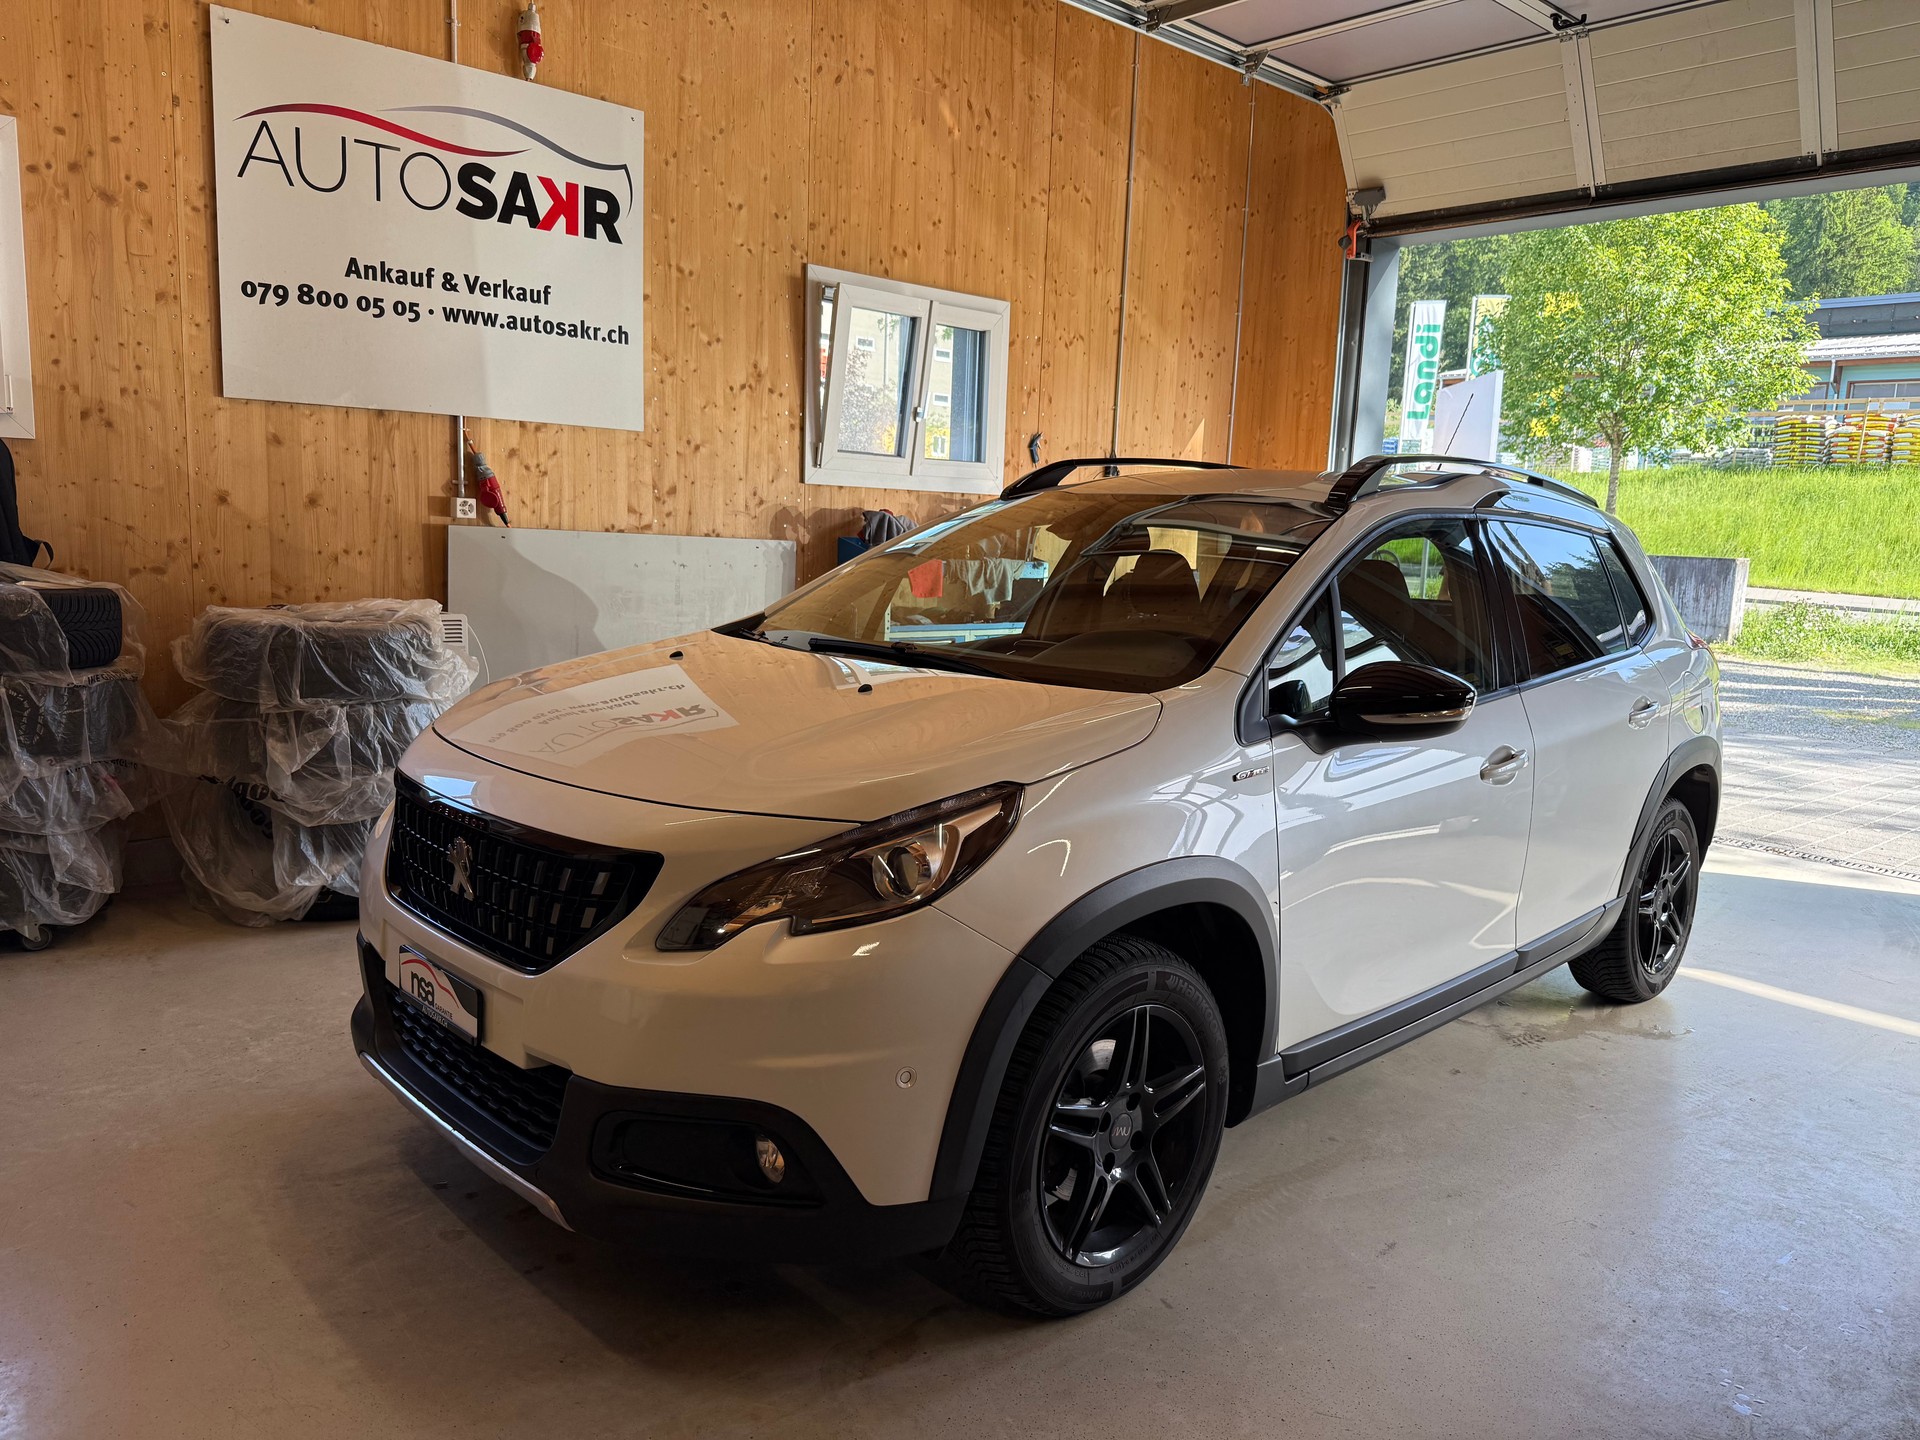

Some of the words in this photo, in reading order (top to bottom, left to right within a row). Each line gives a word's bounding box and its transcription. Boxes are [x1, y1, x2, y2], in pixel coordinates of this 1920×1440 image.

[237, 120, 623, 245] AUTOSAKR
[344, 256, 435, 289] Ankauf
[441, 271, 460, 293] &
[463, 273, 552, 306] Verkauf
[240, 280, 290, 307] 079
[297, 283, 349, 310] 800
[356, 295, 386, 319] 05
[392, 300, 421, 323] 05
[441, 306, 629, 345] www.autosakr.ch
[437, 805, 485, 830] PEUGEOT
[410, 970, 435, 1008] nsa
